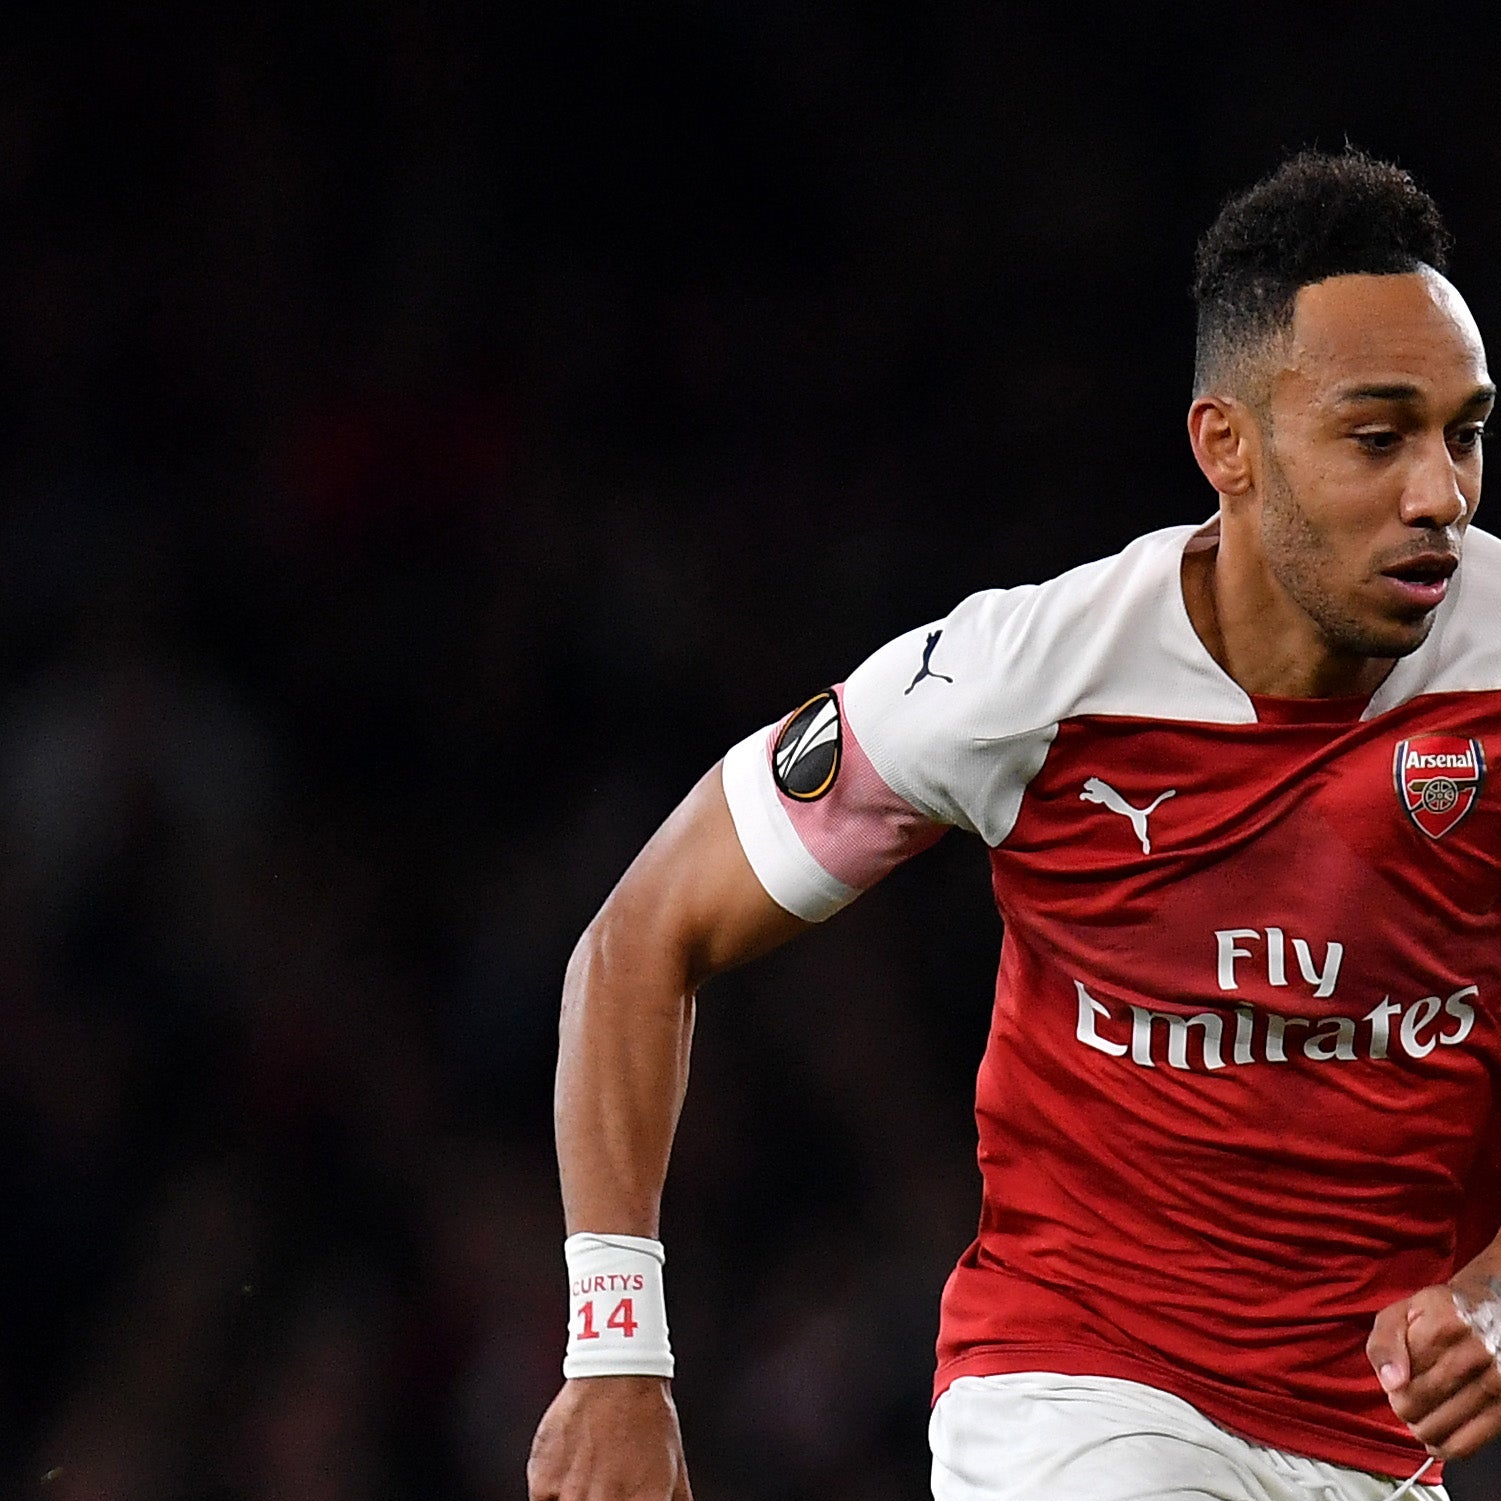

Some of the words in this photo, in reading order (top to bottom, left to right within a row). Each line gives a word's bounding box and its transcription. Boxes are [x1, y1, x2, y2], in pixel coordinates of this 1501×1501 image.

[1406, 749, 1474, 769] Arsenal
[1214, 927, 1344, 998] Fly
[1073, 979, 1480, 1070] Emirates
[572, 1273, 644, 1297] CURTYS
[576, 1298, 639, 1341] 14
